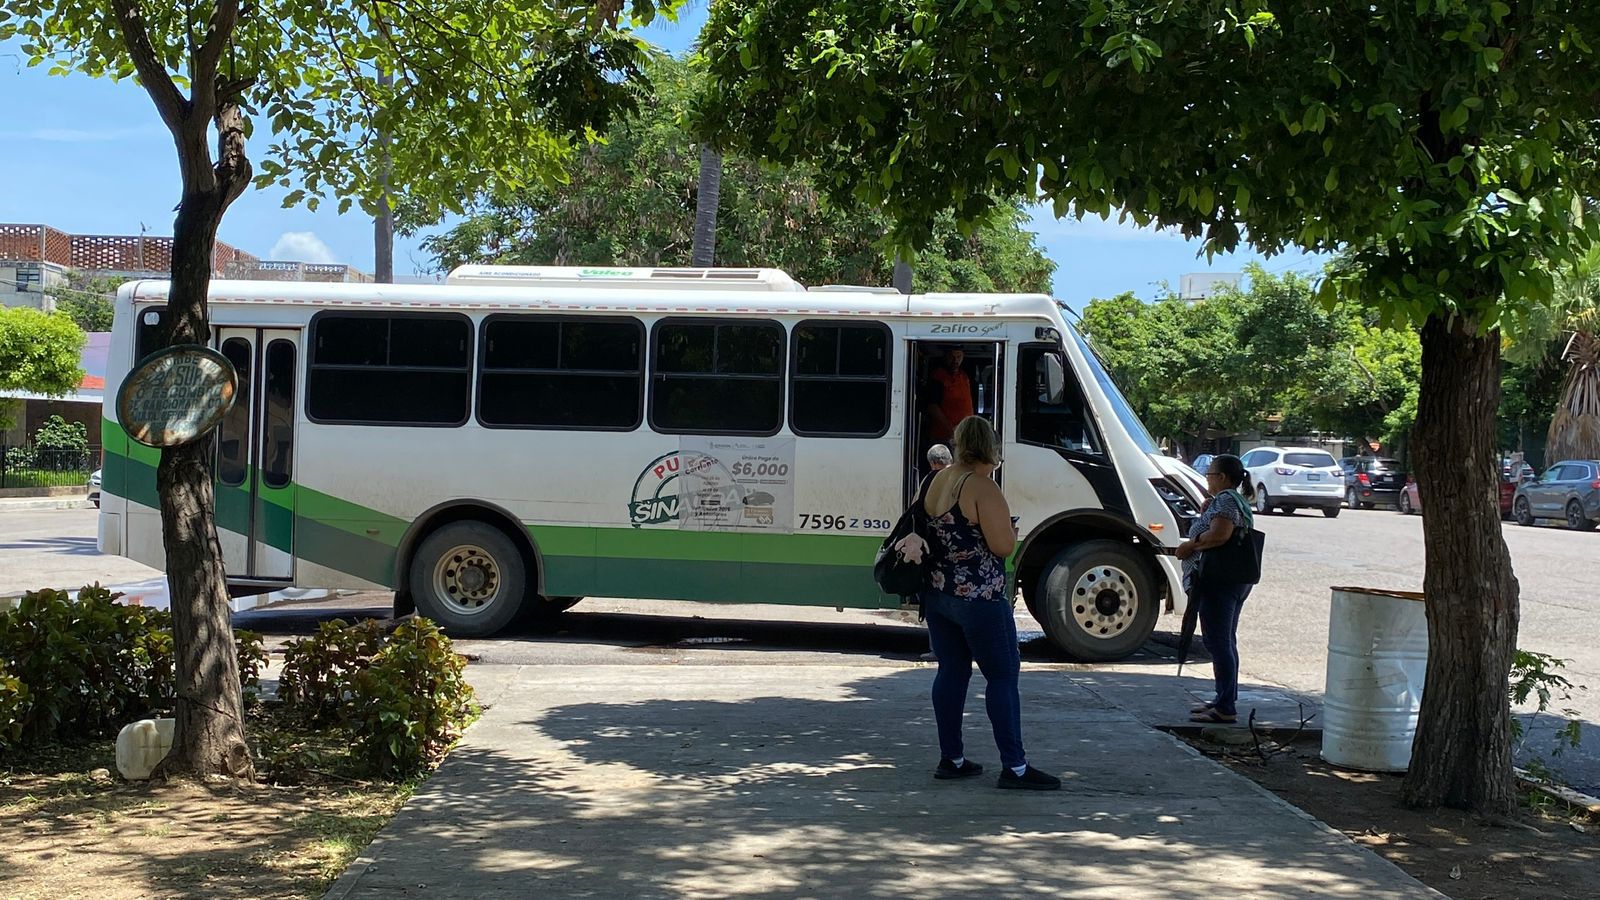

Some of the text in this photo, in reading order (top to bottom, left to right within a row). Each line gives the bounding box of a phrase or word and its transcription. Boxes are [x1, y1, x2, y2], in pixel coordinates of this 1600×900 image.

[930, 323, 978, 334] Zafiro
[731, 460, 789, 478] $6,000
[799, 514, 891, 530] 7596 Z 930
